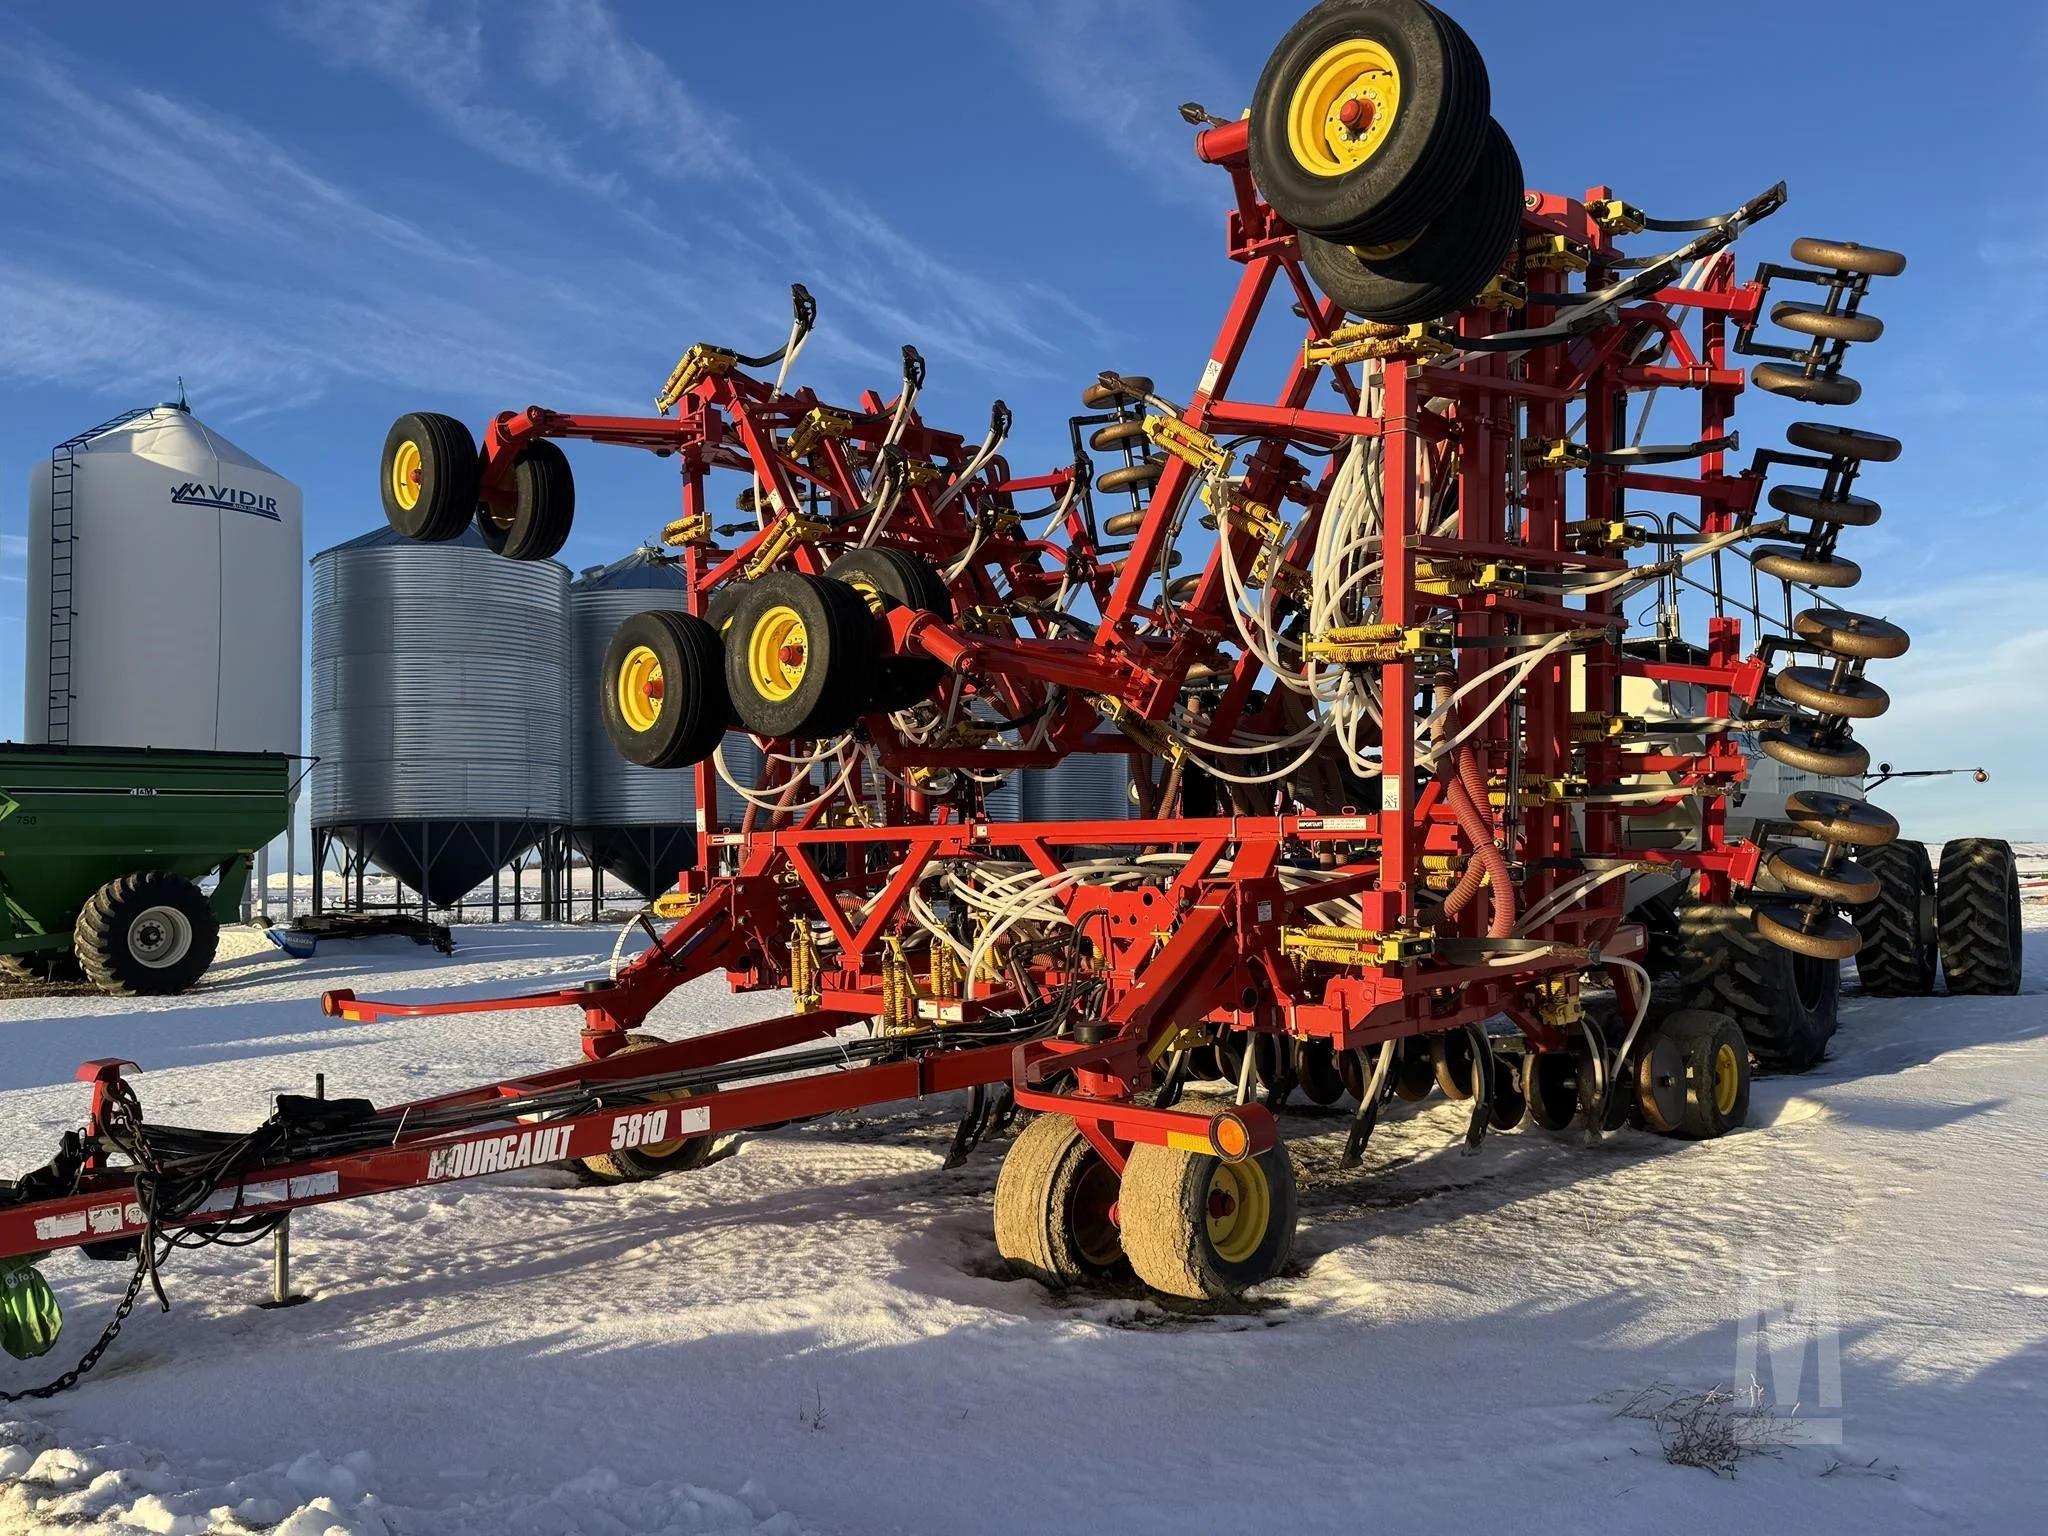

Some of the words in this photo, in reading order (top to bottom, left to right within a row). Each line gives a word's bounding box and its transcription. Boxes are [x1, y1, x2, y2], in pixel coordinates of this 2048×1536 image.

[208, 485, 277, 512] VIDIR
[15, 815, 37, 825] 750
[610, 1110, 668, 1150] 5810
[427, 1124, 575, 1180] BOURGAULT
